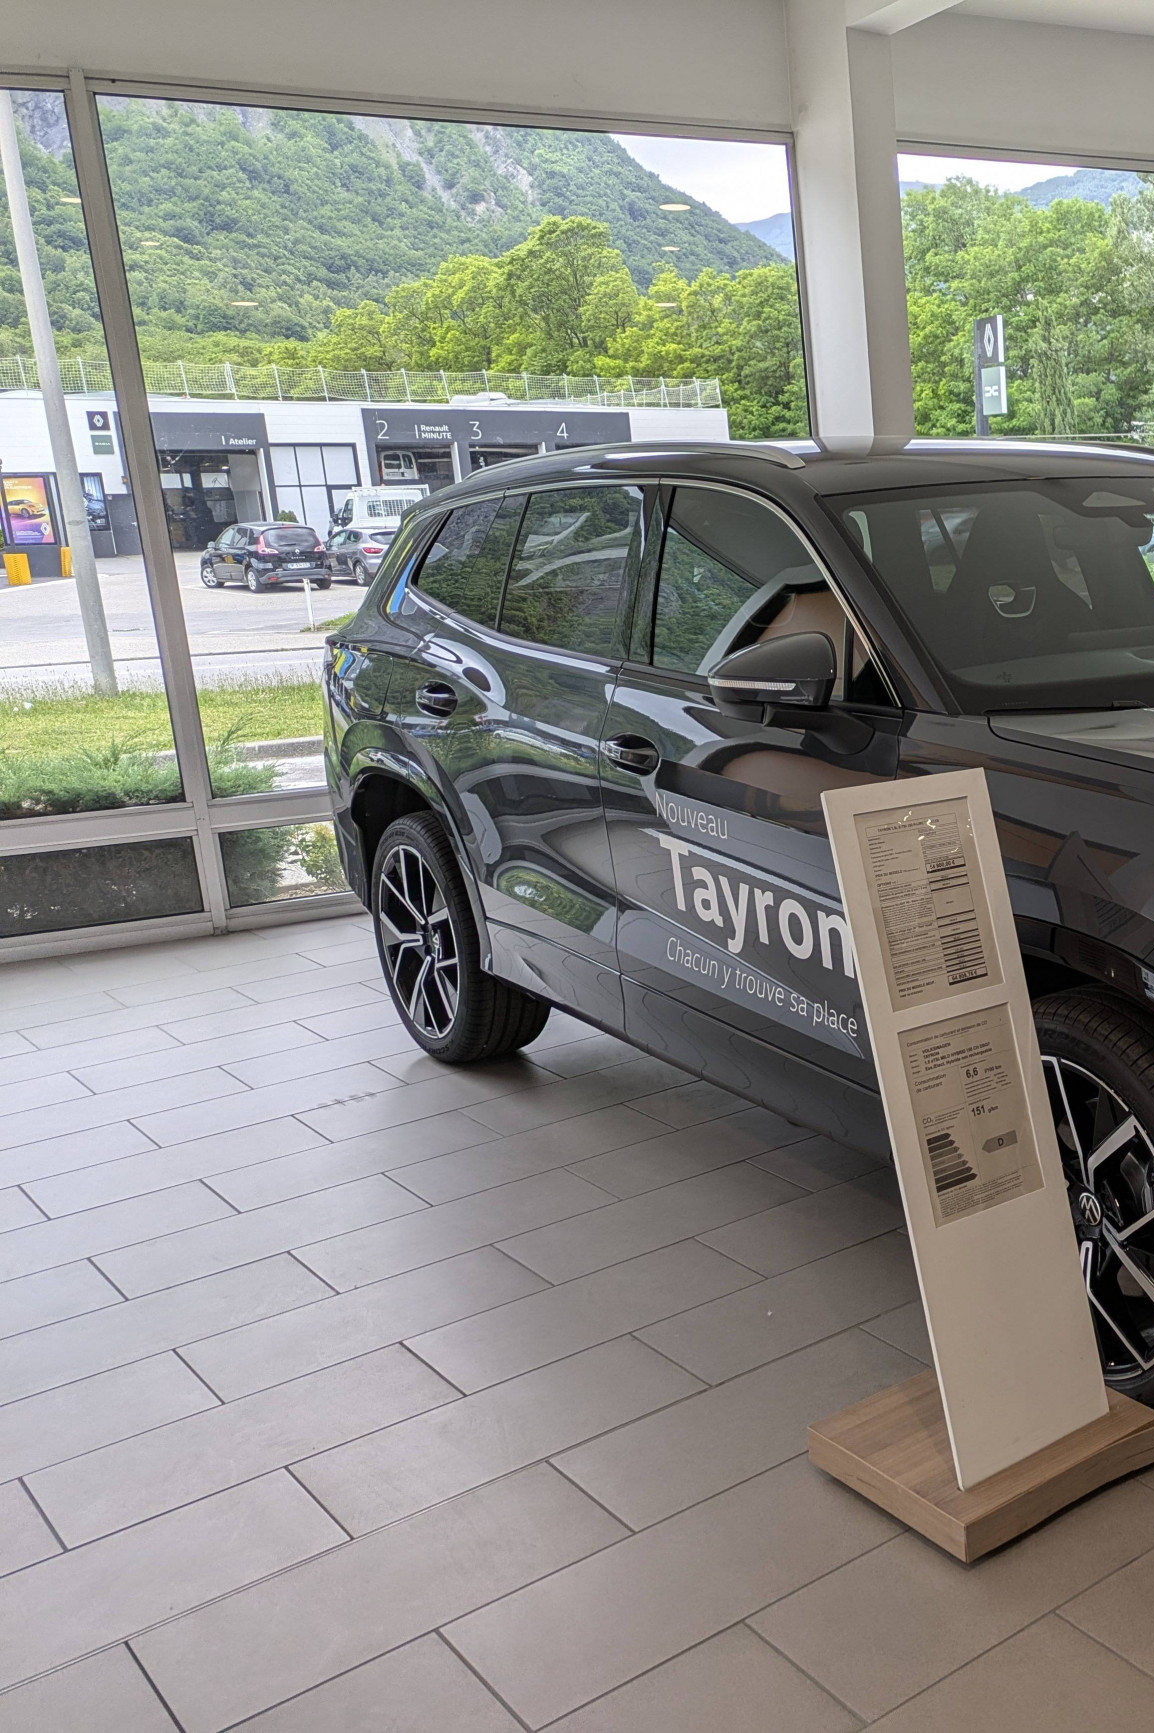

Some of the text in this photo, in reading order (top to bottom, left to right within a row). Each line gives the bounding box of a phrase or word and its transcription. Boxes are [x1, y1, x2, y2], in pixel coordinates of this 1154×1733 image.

[376, 420, 390, 439] 2
[420, 424, 449, 432] Renault
[468, 421, 482, 439] 3
[556, 422, 569, 439] 4
[655, 792, 728, 840] Nouveau
[659, 835, 855, 979] Tayron
[667, 937, 858, 1037] Chacun y trouve sa place
[921, 1042, 951, 1054] VOLKSWAGEN
[922, 1051, 939, 1059] TAYRON
[914, 1073, 947, 1086] Consommation
[965, 1067, 979, 1079] 6,6
[971, 1104, 986, 1117] 151
[997, 1137, 1004, 1147] D
